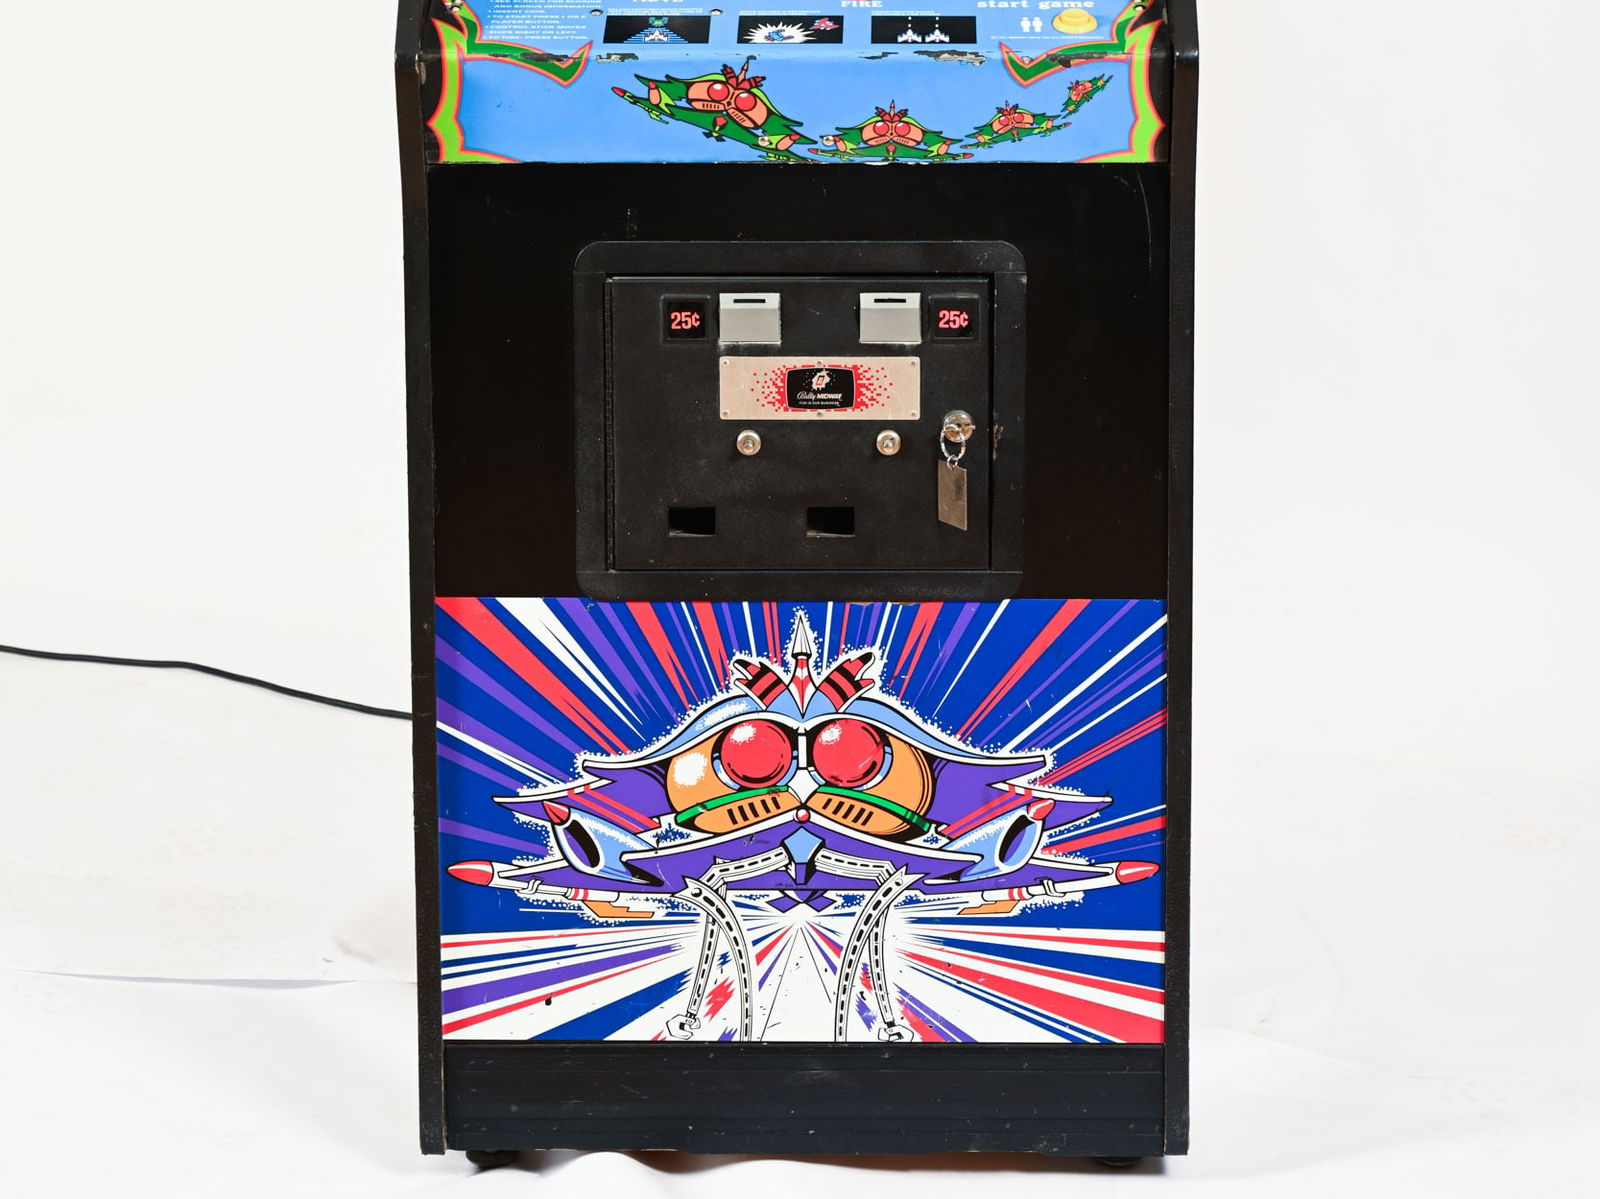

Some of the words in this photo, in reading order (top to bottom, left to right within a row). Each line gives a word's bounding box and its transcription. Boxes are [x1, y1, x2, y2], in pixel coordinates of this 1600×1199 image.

[841, 0, 883, 8] FIRE
[976, 0, 1030, 8] start
[1038, 0, 1095, 10] game
[670, 311, 701, 330] 25¢
[938, 309, 969, 329] 25¢
[817, 392, 843, 400] MIDWAY
